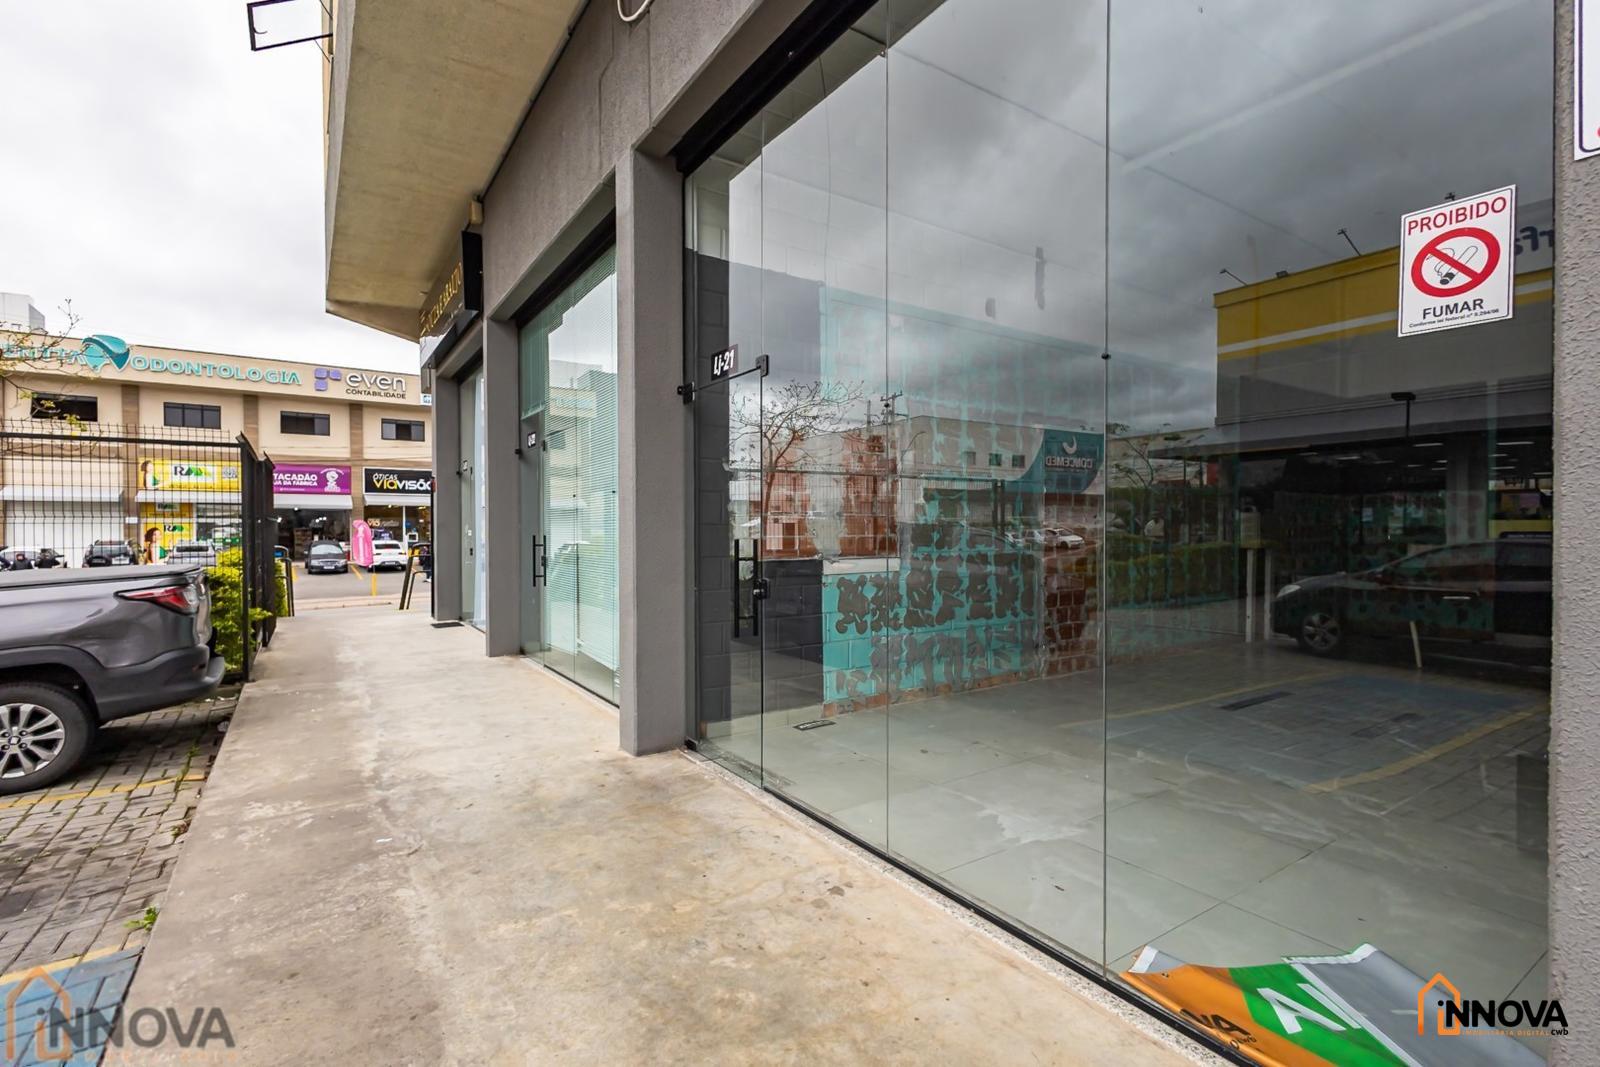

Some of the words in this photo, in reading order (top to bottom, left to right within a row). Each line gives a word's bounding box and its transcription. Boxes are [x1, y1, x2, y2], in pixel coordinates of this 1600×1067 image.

[1407, 196, 1507, 236] PROIBIDO
[1423, 298, 1484, 320] FUMAR
[130, 355, 302, 385] ODONTOLOGIA
[346, 372, 406, 391] even
[345, 388, 406, 399] CONTABILIDADE
[273, 473, 318, 482] TACADÃO
